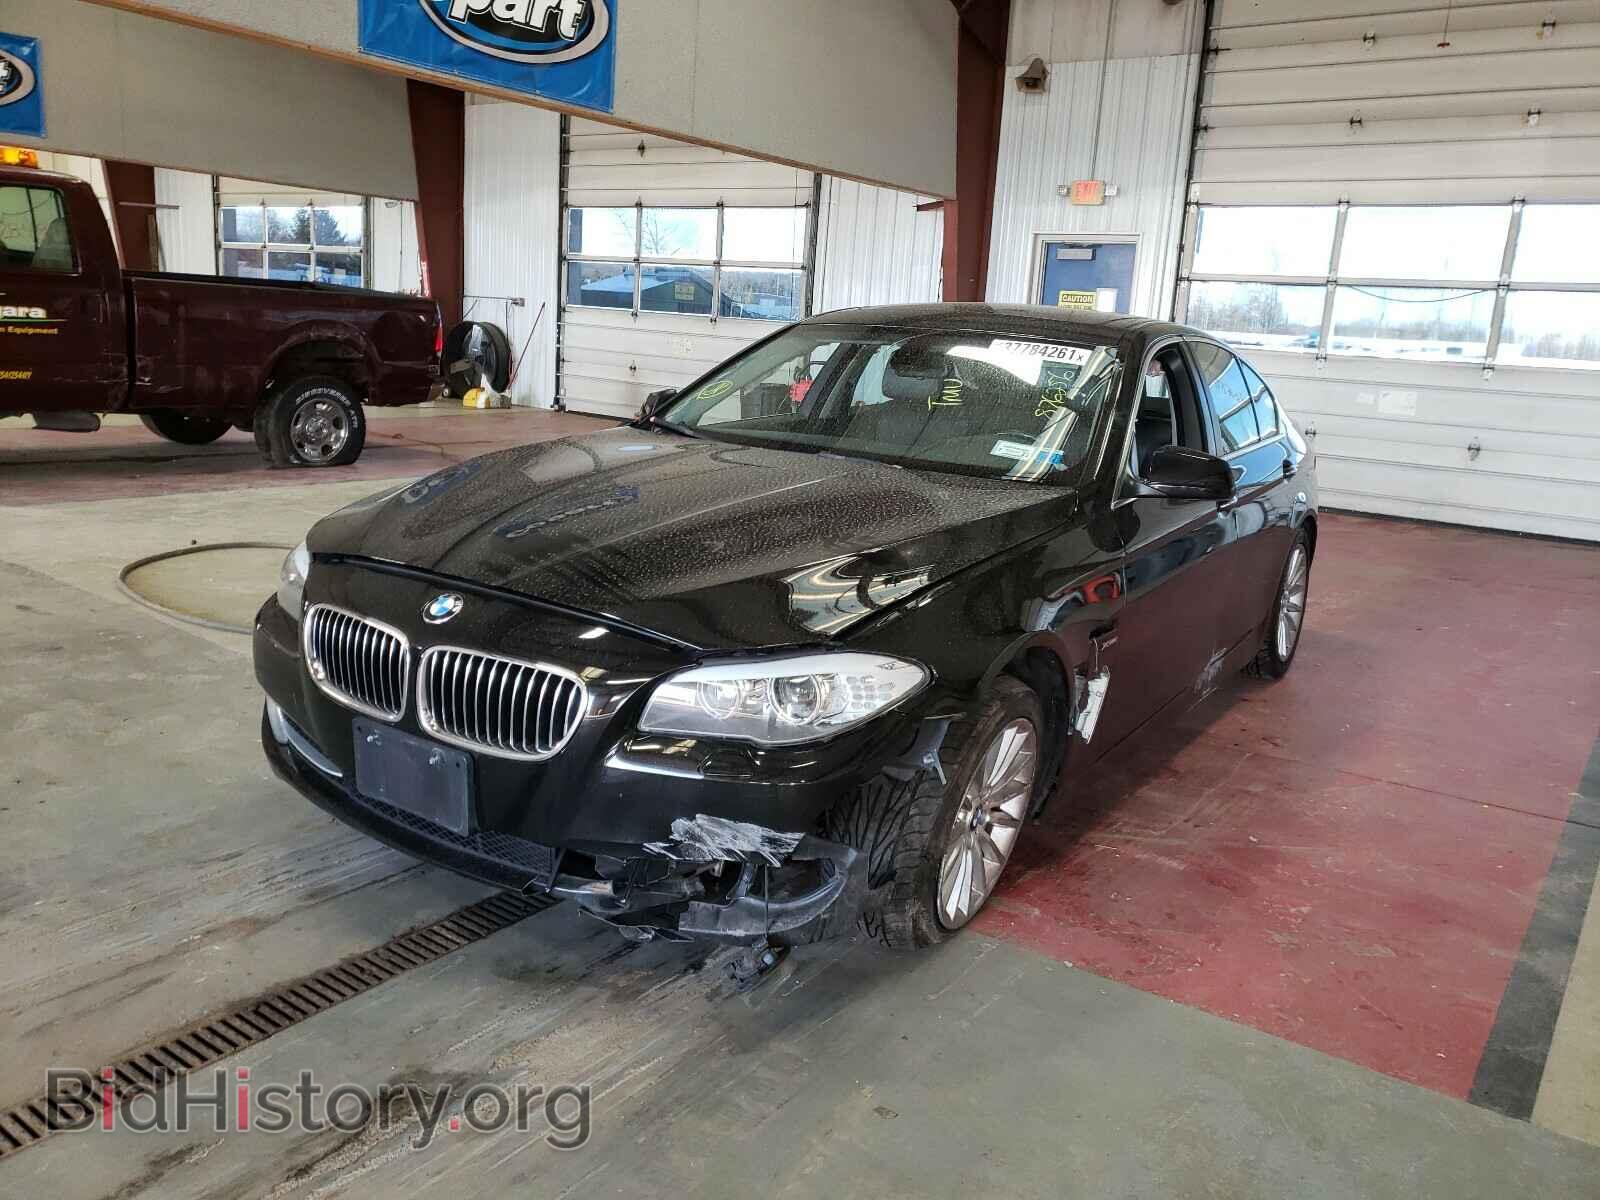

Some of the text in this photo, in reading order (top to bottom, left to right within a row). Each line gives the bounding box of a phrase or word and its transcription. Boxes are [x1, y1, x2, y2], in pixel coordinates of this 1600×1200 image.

[1075, 182, 1100, 201] EXIT
[1062, 294, 1095, 304] CAUTION
[0, 306, 47, 319] ara
[8, 326, 58, 335] Equipment
